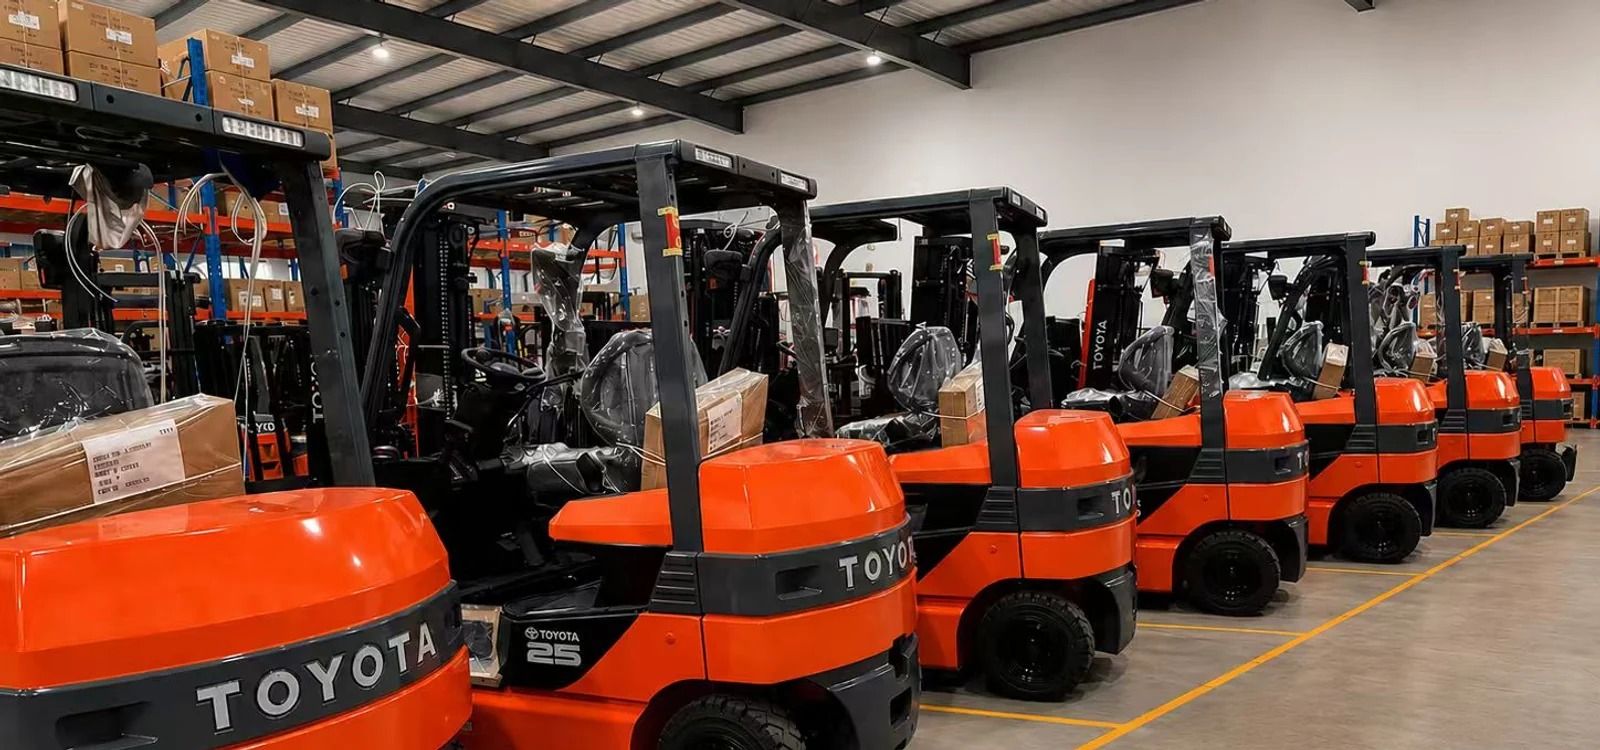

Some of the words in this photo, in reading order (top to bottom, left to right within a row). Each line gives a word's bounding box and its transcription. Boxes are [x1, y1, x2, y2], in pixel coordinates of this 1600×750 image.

[539, 629, 580, 642] TOYOTA
[526, 641, 582, 667] 25
[196, 622, 438, 731] TOYOTA
